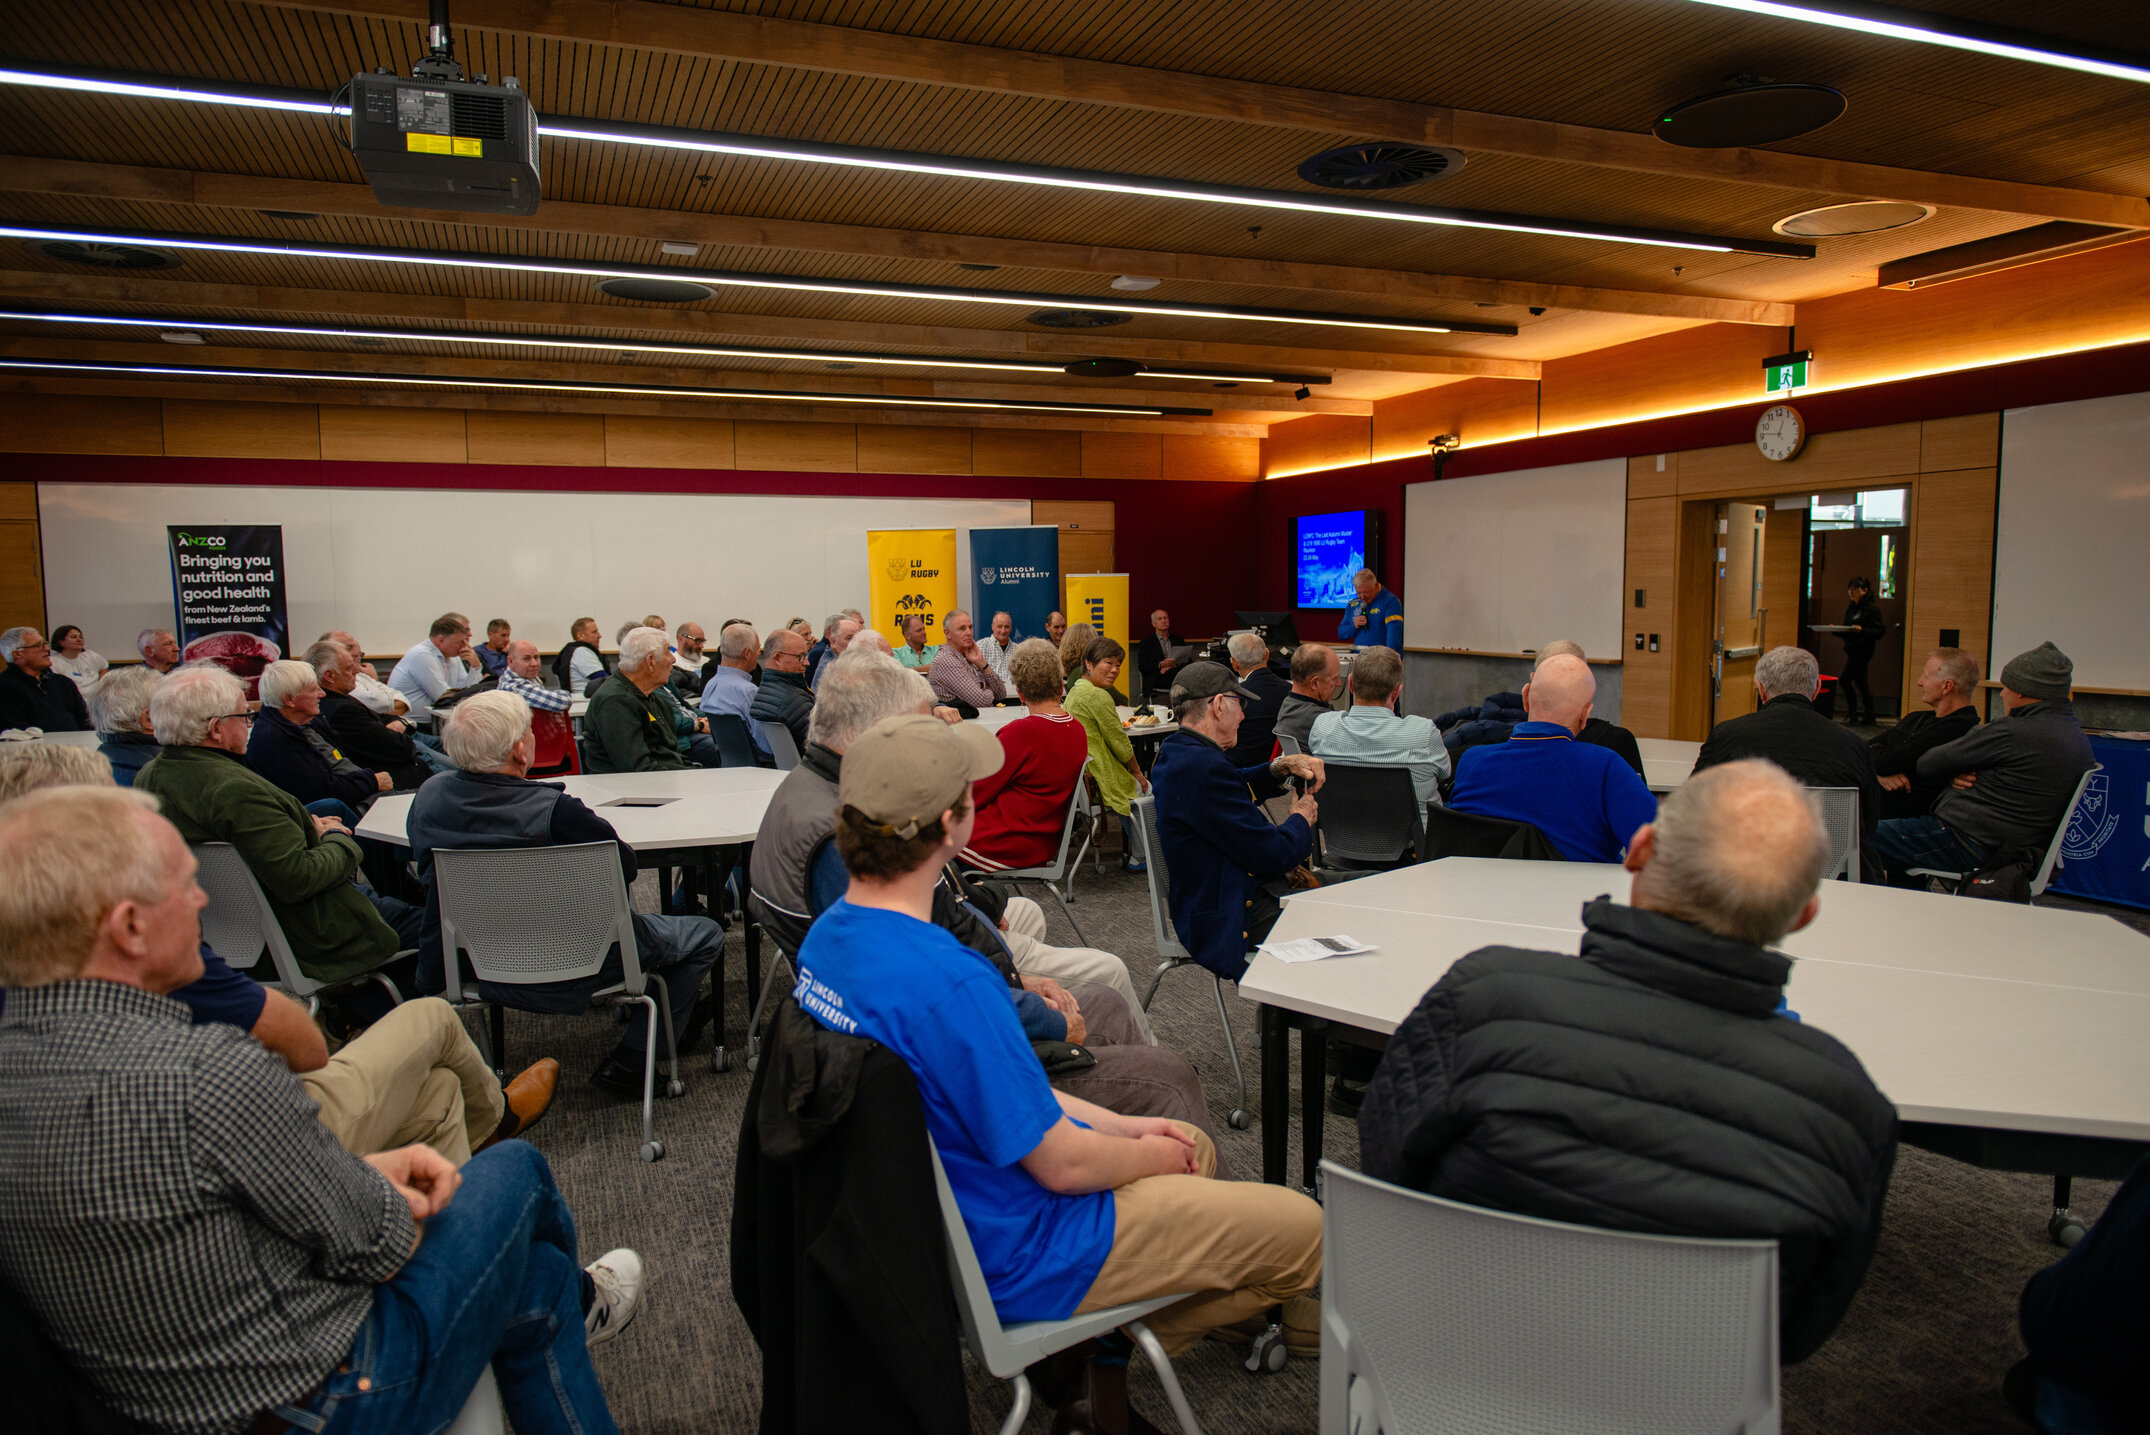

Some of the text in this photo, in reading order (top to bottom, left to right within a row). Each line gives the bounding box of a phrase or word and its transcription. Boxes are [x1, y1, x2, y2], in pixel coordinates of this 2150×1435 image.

[178, 535, 226, 546] ANZCO
[180, 554, 271, 570] Bringing you
[910, 559, 922, 568] LU
[181, 569, 274, 583] nutrition and
[910, 569, 939, 578] RUGBY
[183, 586, 271, 603] good health
[184, 604, 271, 614] from New Zealand's
[185, 616, 210, 624] finest
[233, 615, 241, 623] &
[242, 615, 266, 623] lamb.
[811, 979, 843, 1009] LINCOLN
[804, 992, 858, 1034] UNIVERSITY
